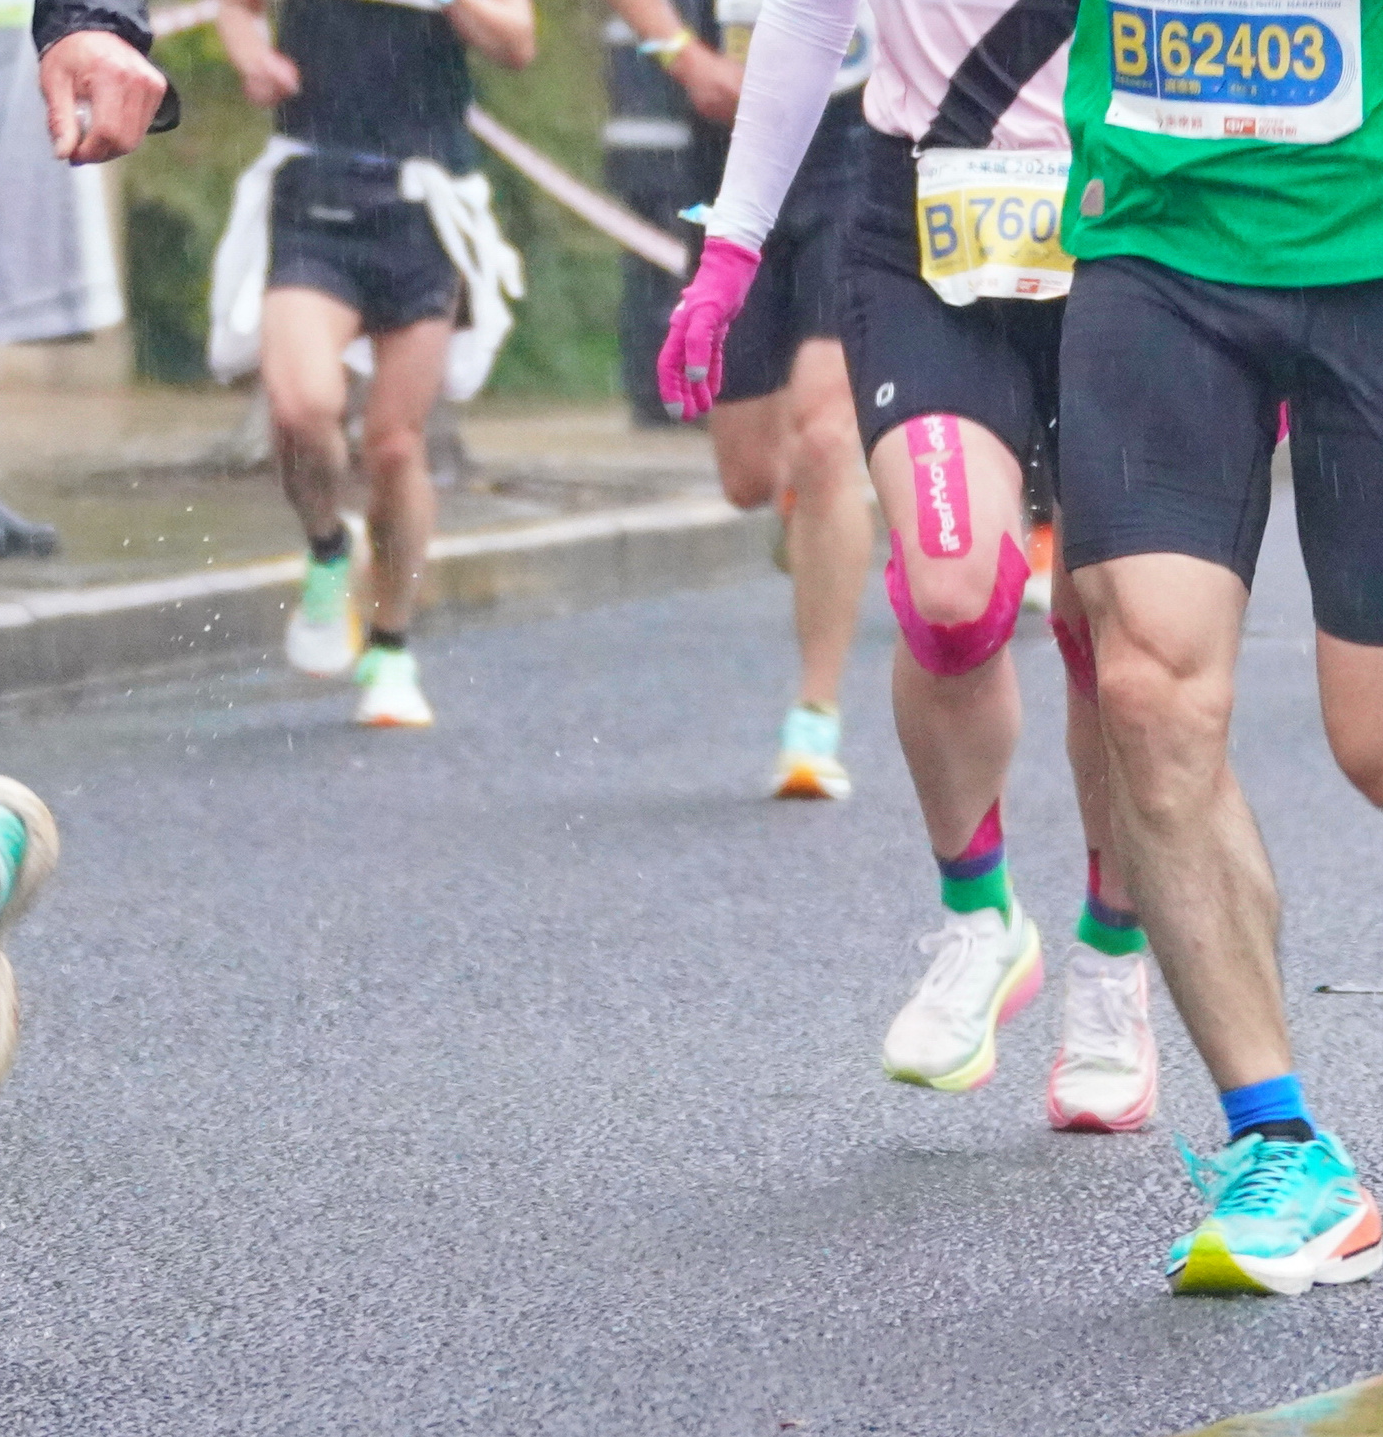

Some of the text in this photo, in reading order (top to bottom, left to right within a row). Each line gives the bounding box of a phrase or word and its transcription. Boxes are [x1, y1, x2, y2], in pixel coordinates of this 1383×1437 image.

[1112, 10, 1326, 80] B 62403
[925, 202, 959, 261] B
